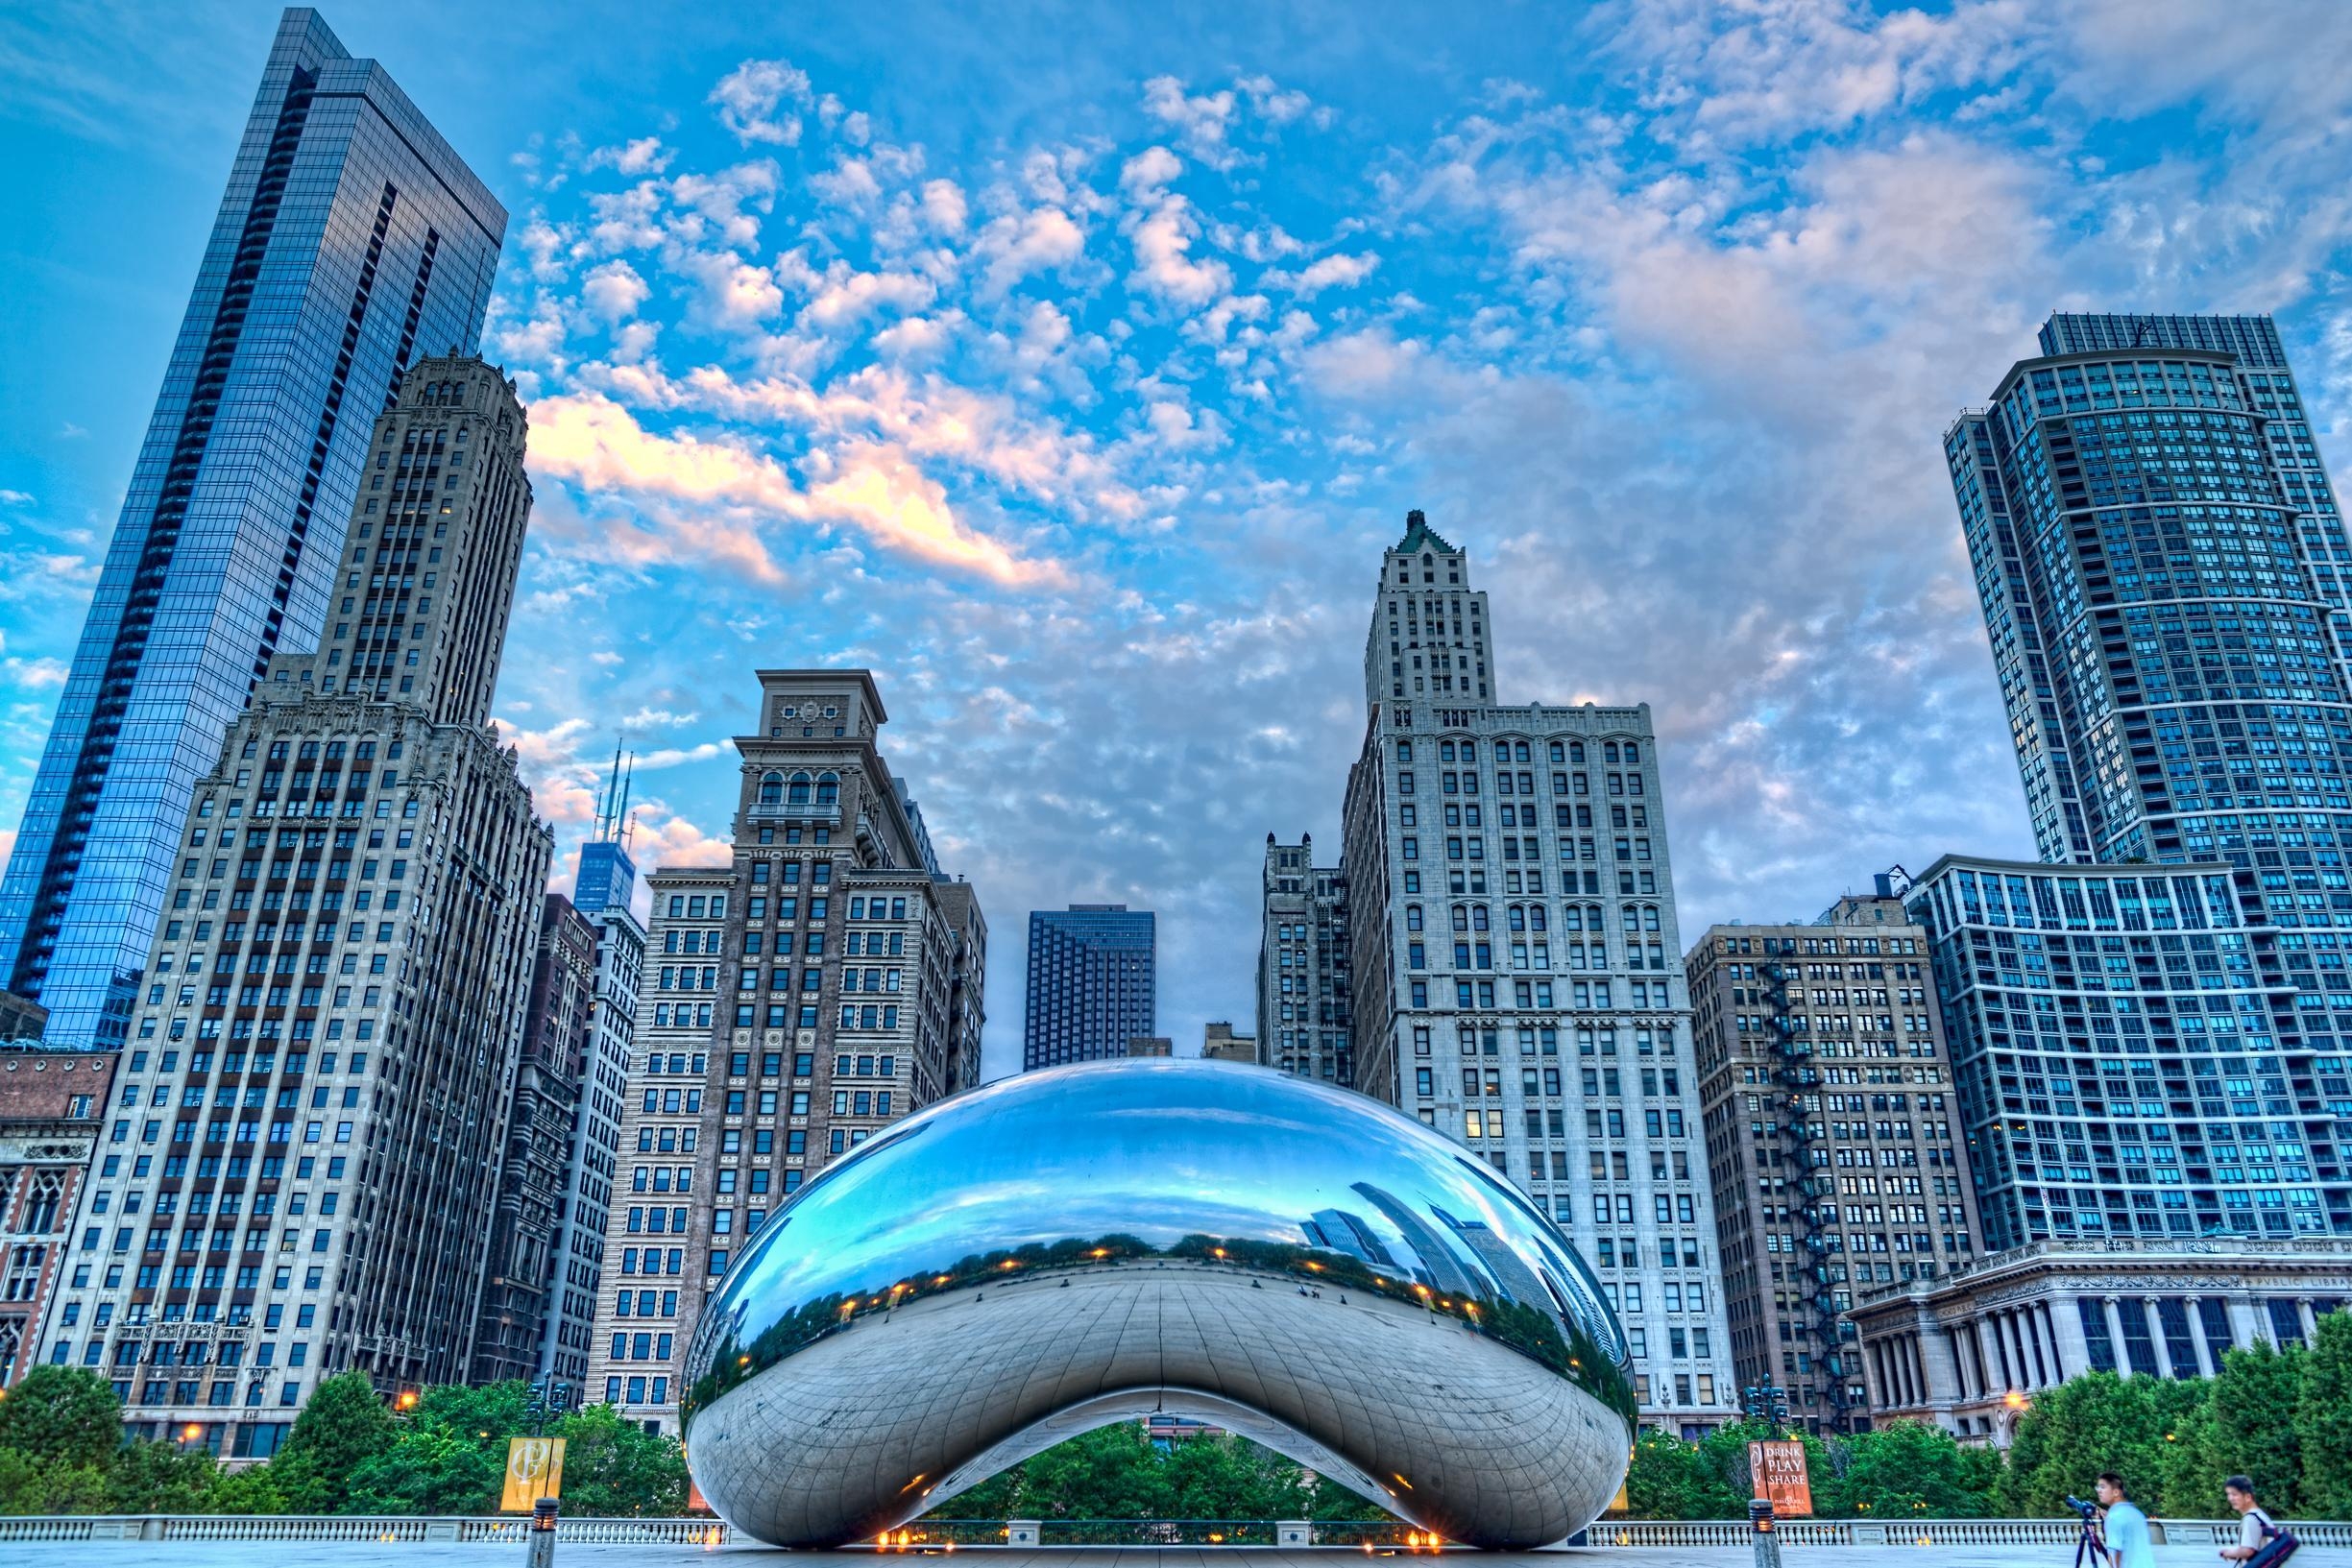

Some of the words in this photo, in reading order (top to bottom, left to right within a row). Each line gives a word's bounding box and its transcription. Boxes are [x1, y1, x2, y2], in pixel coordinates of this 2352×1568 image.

[1766, 1448, 1802, 1457] DRINK
[1768, 1460, 1802, 1472] PLAY
[1769, 1475, 1806, 1484] SHARE
